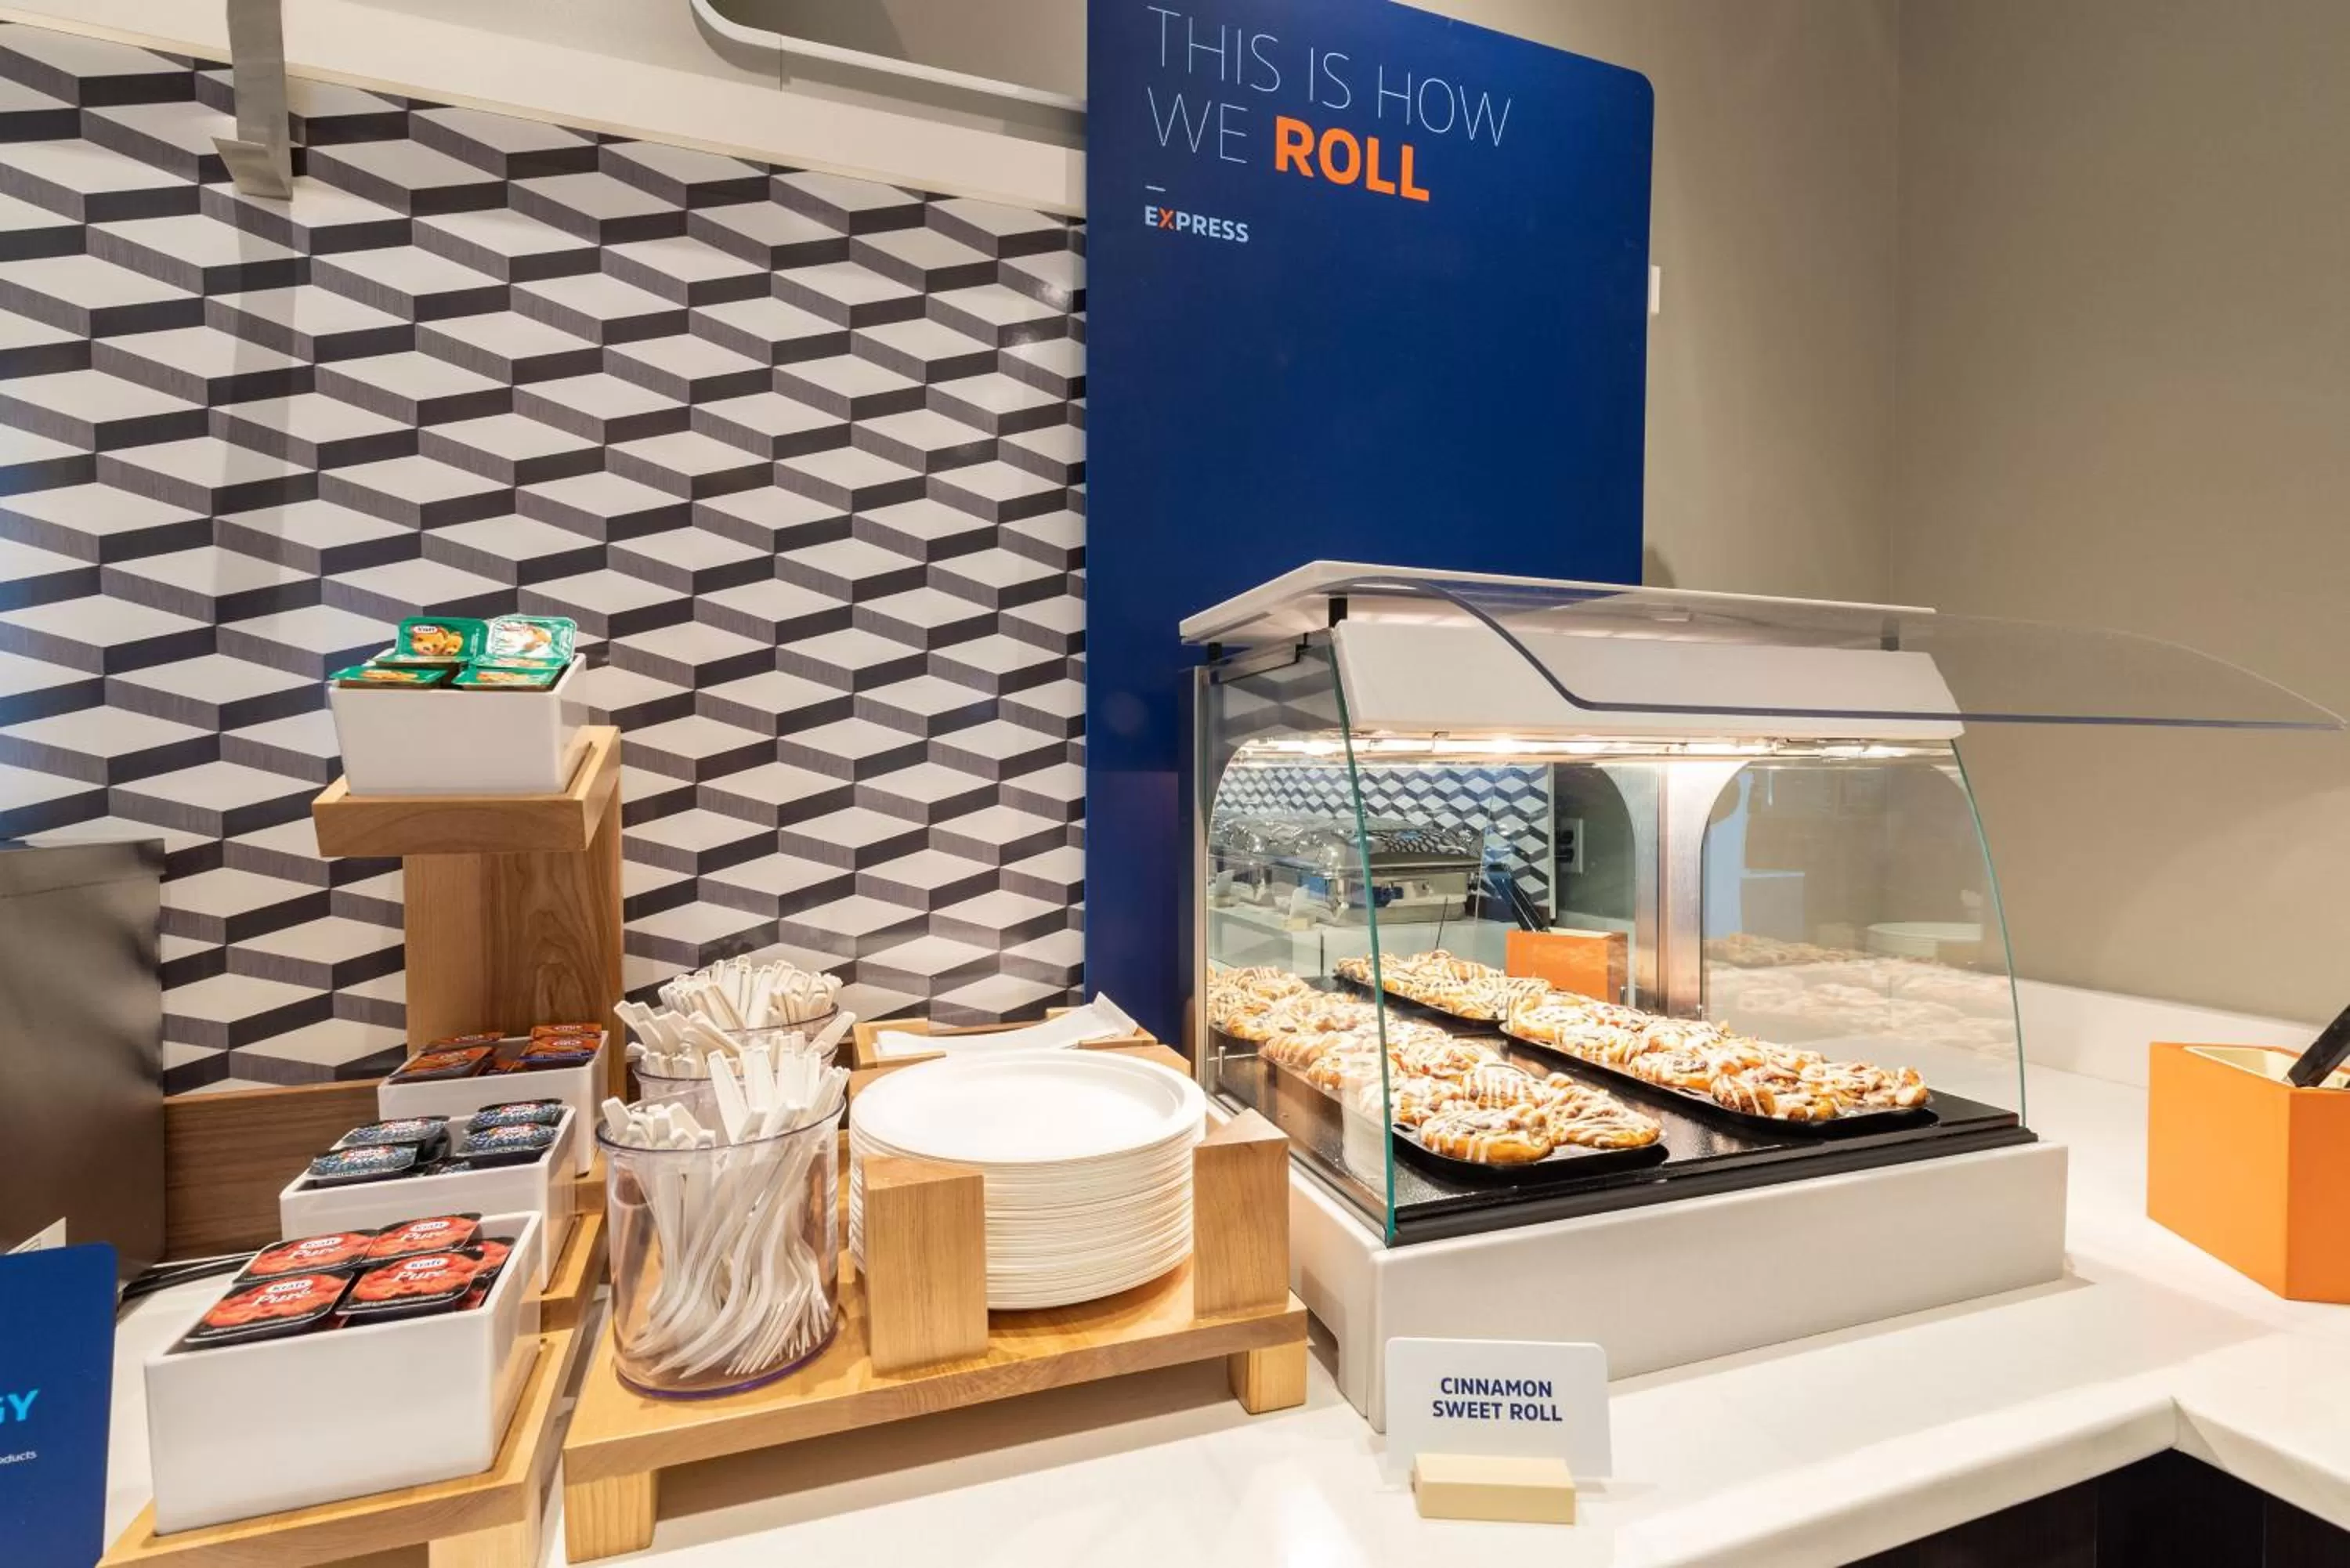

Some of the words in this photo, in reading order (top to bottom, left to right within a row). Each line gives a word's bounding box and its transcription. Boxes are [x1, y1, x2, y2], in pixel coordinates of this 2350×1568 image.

[1147, 5, 1281, 92] THIS
[1309, 47, 1352, 110] IS
[1377, 64, 1511, 146] HOW
[1147, 86, 1248, 164] WE
[1275, 115, 1430, 203] ROLL
[1144, 204, 1249, 244] EXPRESS
[1440, 1377, 1553, 1398] CINNAMON
[1432, 1400, 1502, 1420] SWEET
[1509, 1404, 1564, 1422] ROLL
